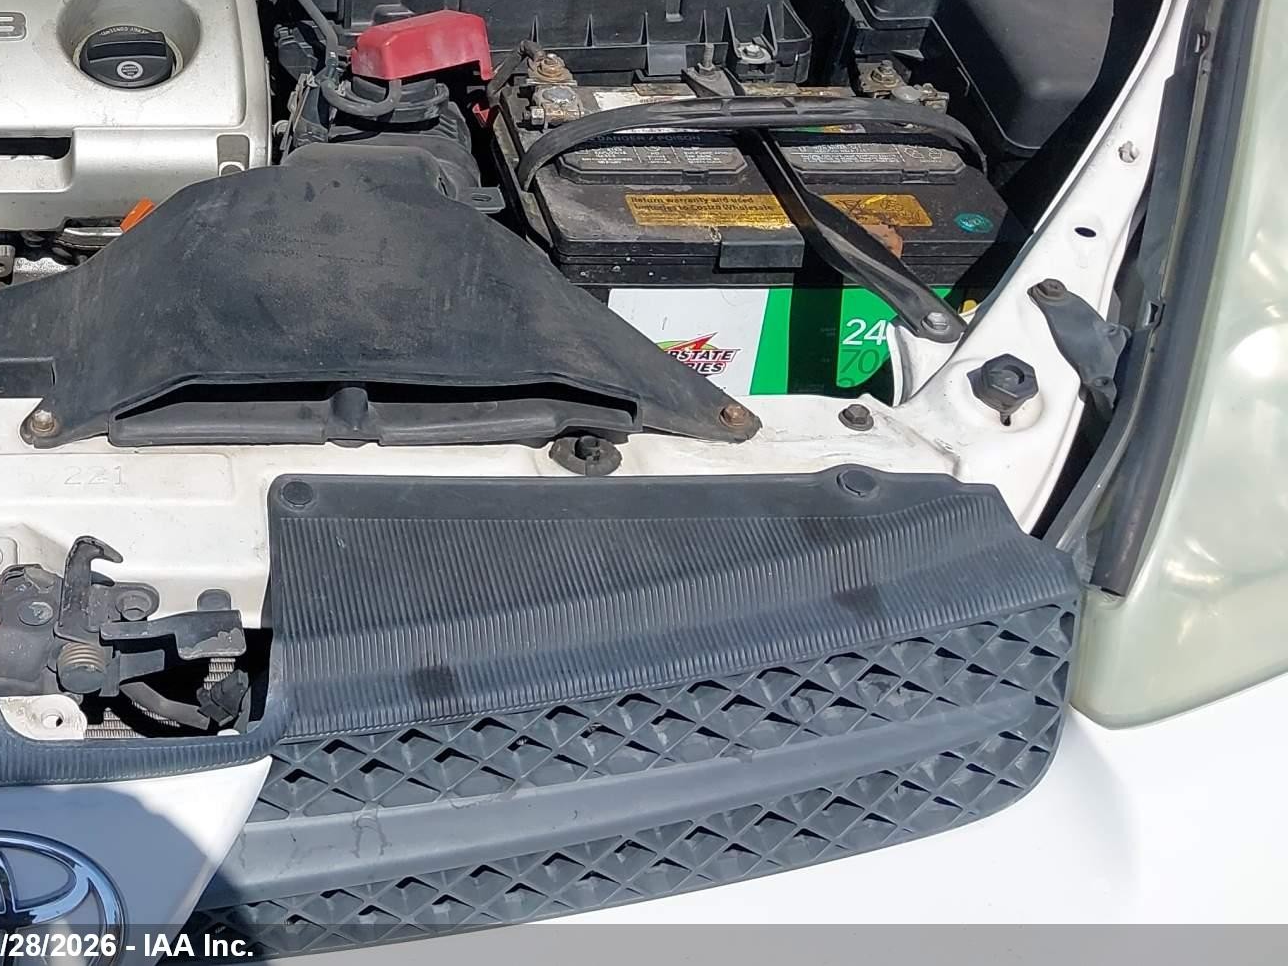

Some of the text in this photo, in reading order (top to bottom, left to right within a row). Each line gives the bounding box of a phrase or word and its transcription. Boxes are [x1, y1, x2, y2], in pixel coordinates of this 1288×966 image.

[666, 196, 708, 205] warranty
[842, 318, 887, 346] 24
[839, 348, 880, 374] 70
